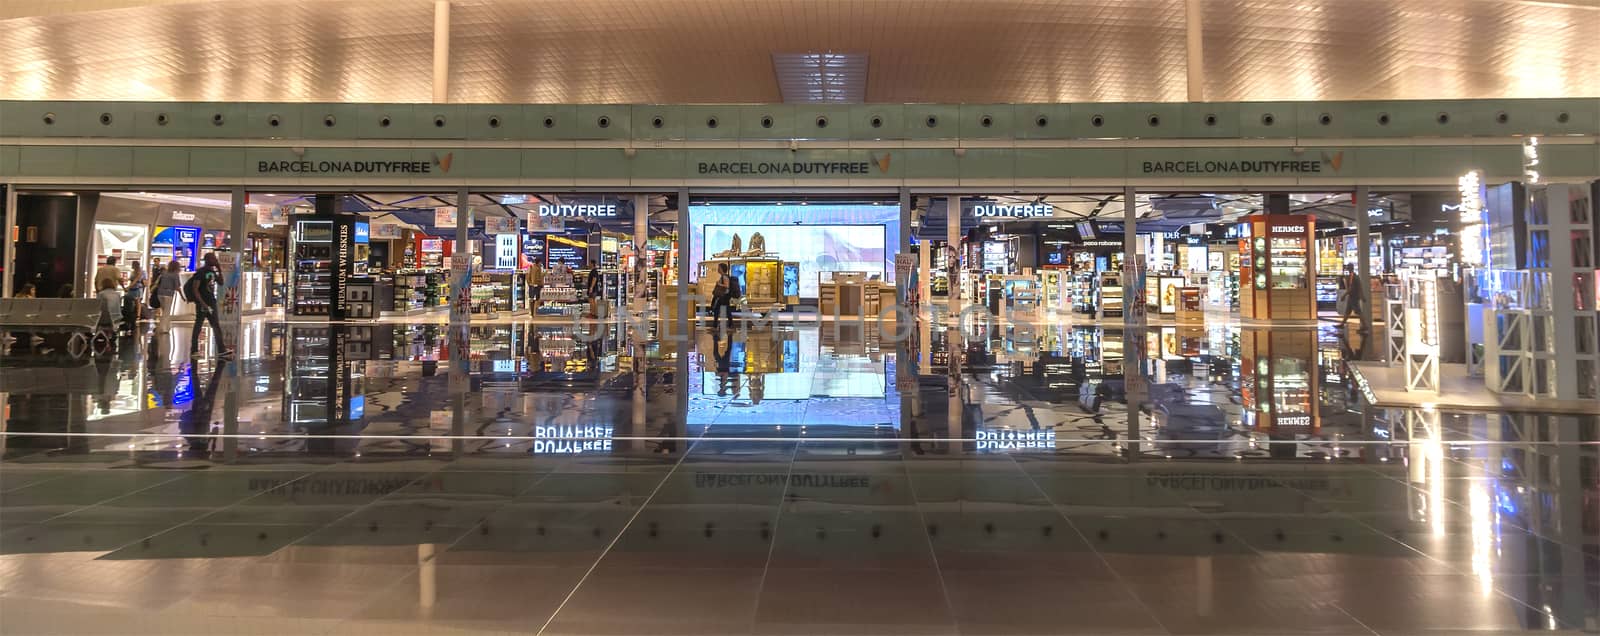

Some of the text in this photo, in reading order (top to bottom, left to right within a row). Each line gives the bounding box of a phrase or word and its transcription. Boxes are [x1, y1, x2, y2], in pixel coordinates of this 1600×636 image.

[538, 204, 617, 217] DUTYFREE
[974, 205, 1054, 217] DUTYFREE
[337, 224, 348, 310] PREMIUM WHISKIES
